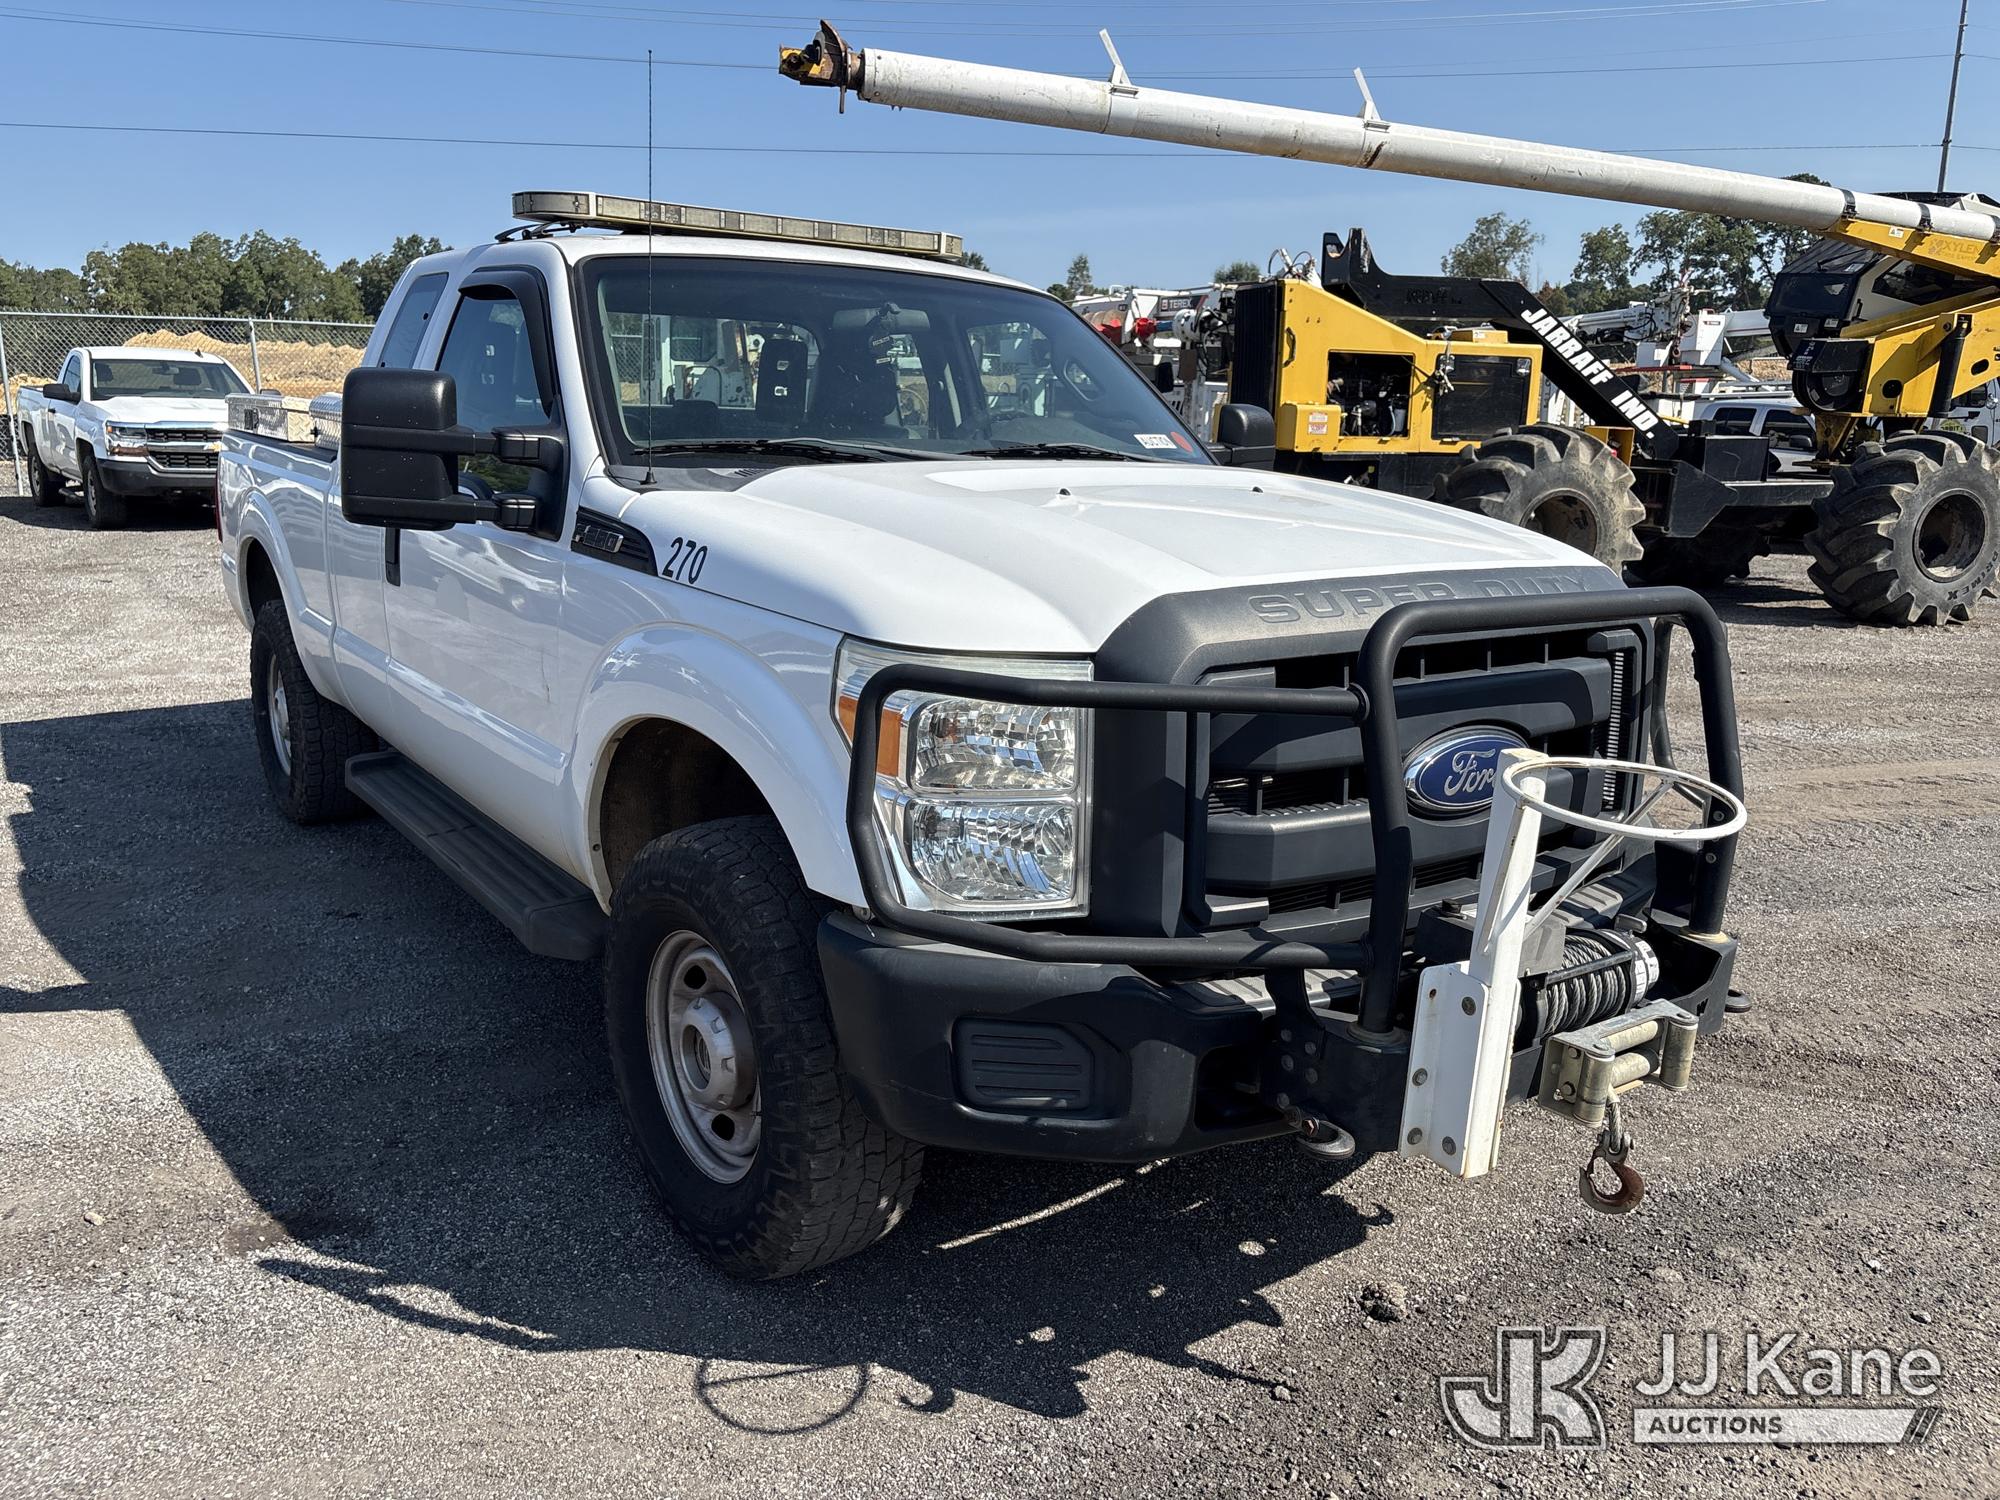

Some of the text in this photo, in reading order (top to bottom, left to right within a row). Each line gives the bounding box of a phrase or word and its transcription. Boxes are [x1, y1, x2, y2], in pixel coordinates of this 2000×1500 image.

[1168, 298, 1192, 309] TEREX
[1520, 308, 1659, 439] JARRAFF IND.
[661, 536, 708, 585] 270
[1947, 550, 1999, 600] PRIMEX
[1248, 581, 1458, 624] SUPER
[1443, 748, 1497, 797] For
